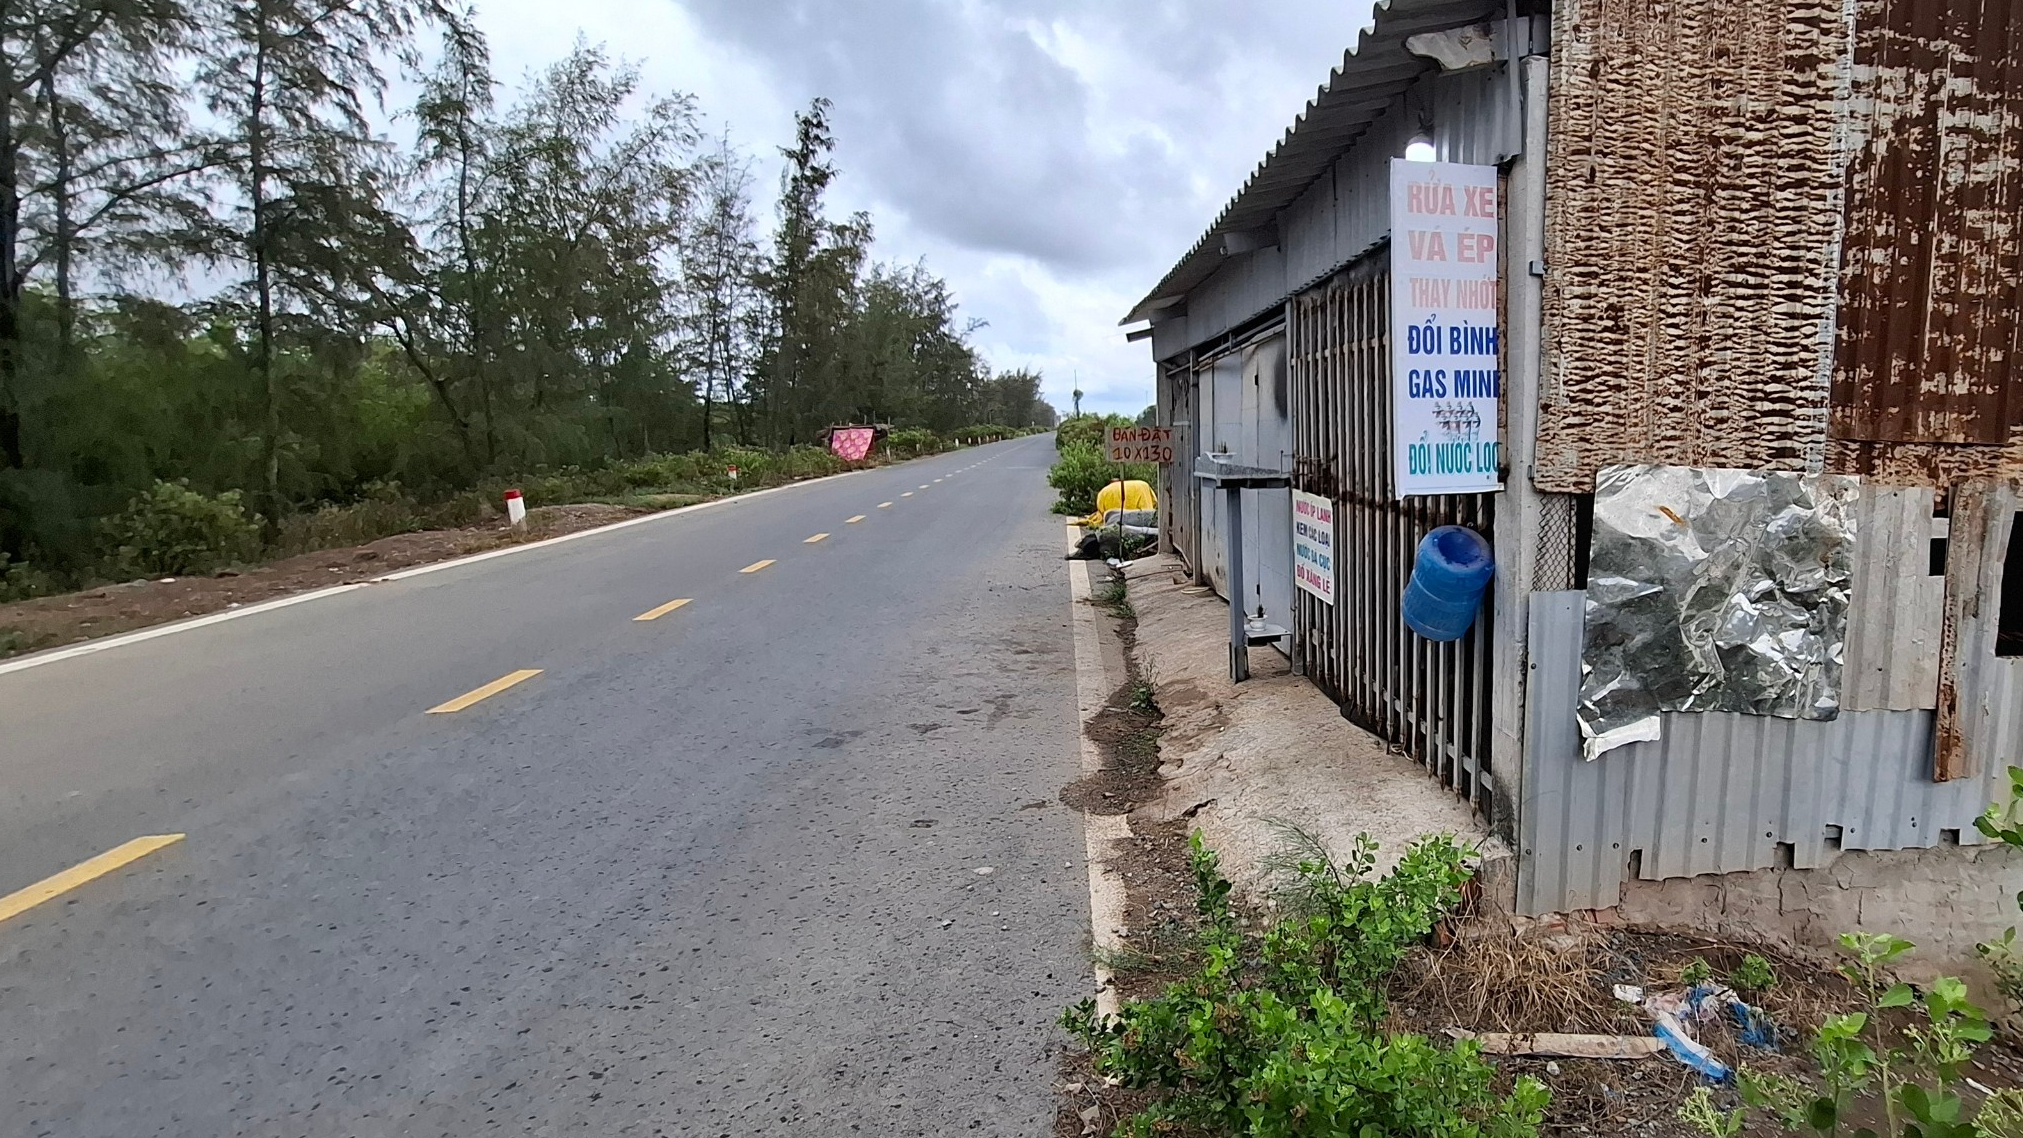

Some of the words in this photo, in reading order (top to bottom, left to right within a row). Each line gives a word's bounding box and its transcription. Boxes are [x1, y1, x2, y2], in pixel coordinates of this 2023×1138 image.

[1407, 170, 1456, 216] RỬA
[1464, 186, 1495, 219] XE
[1408, 225, 1447, 262] VÁ
[1457, 227, 1495, 264] ÉP
[1410, 277, 1451, 309] THAY
[1456, 274, 1498, 310] NHỚT
[1407, 314, 1442, 355] ĐỔI
[1450, 320, 1498, 356] BÌNH
[1408, 369, 1447, 399] GAS
[1112, 426, 1136, 442] BÁN
[1408, 430, 1432, 475] ĐỔI
[1436, 435, 1472, 474] NƯỚC
[1296, 521, 1307, 537] KEM
